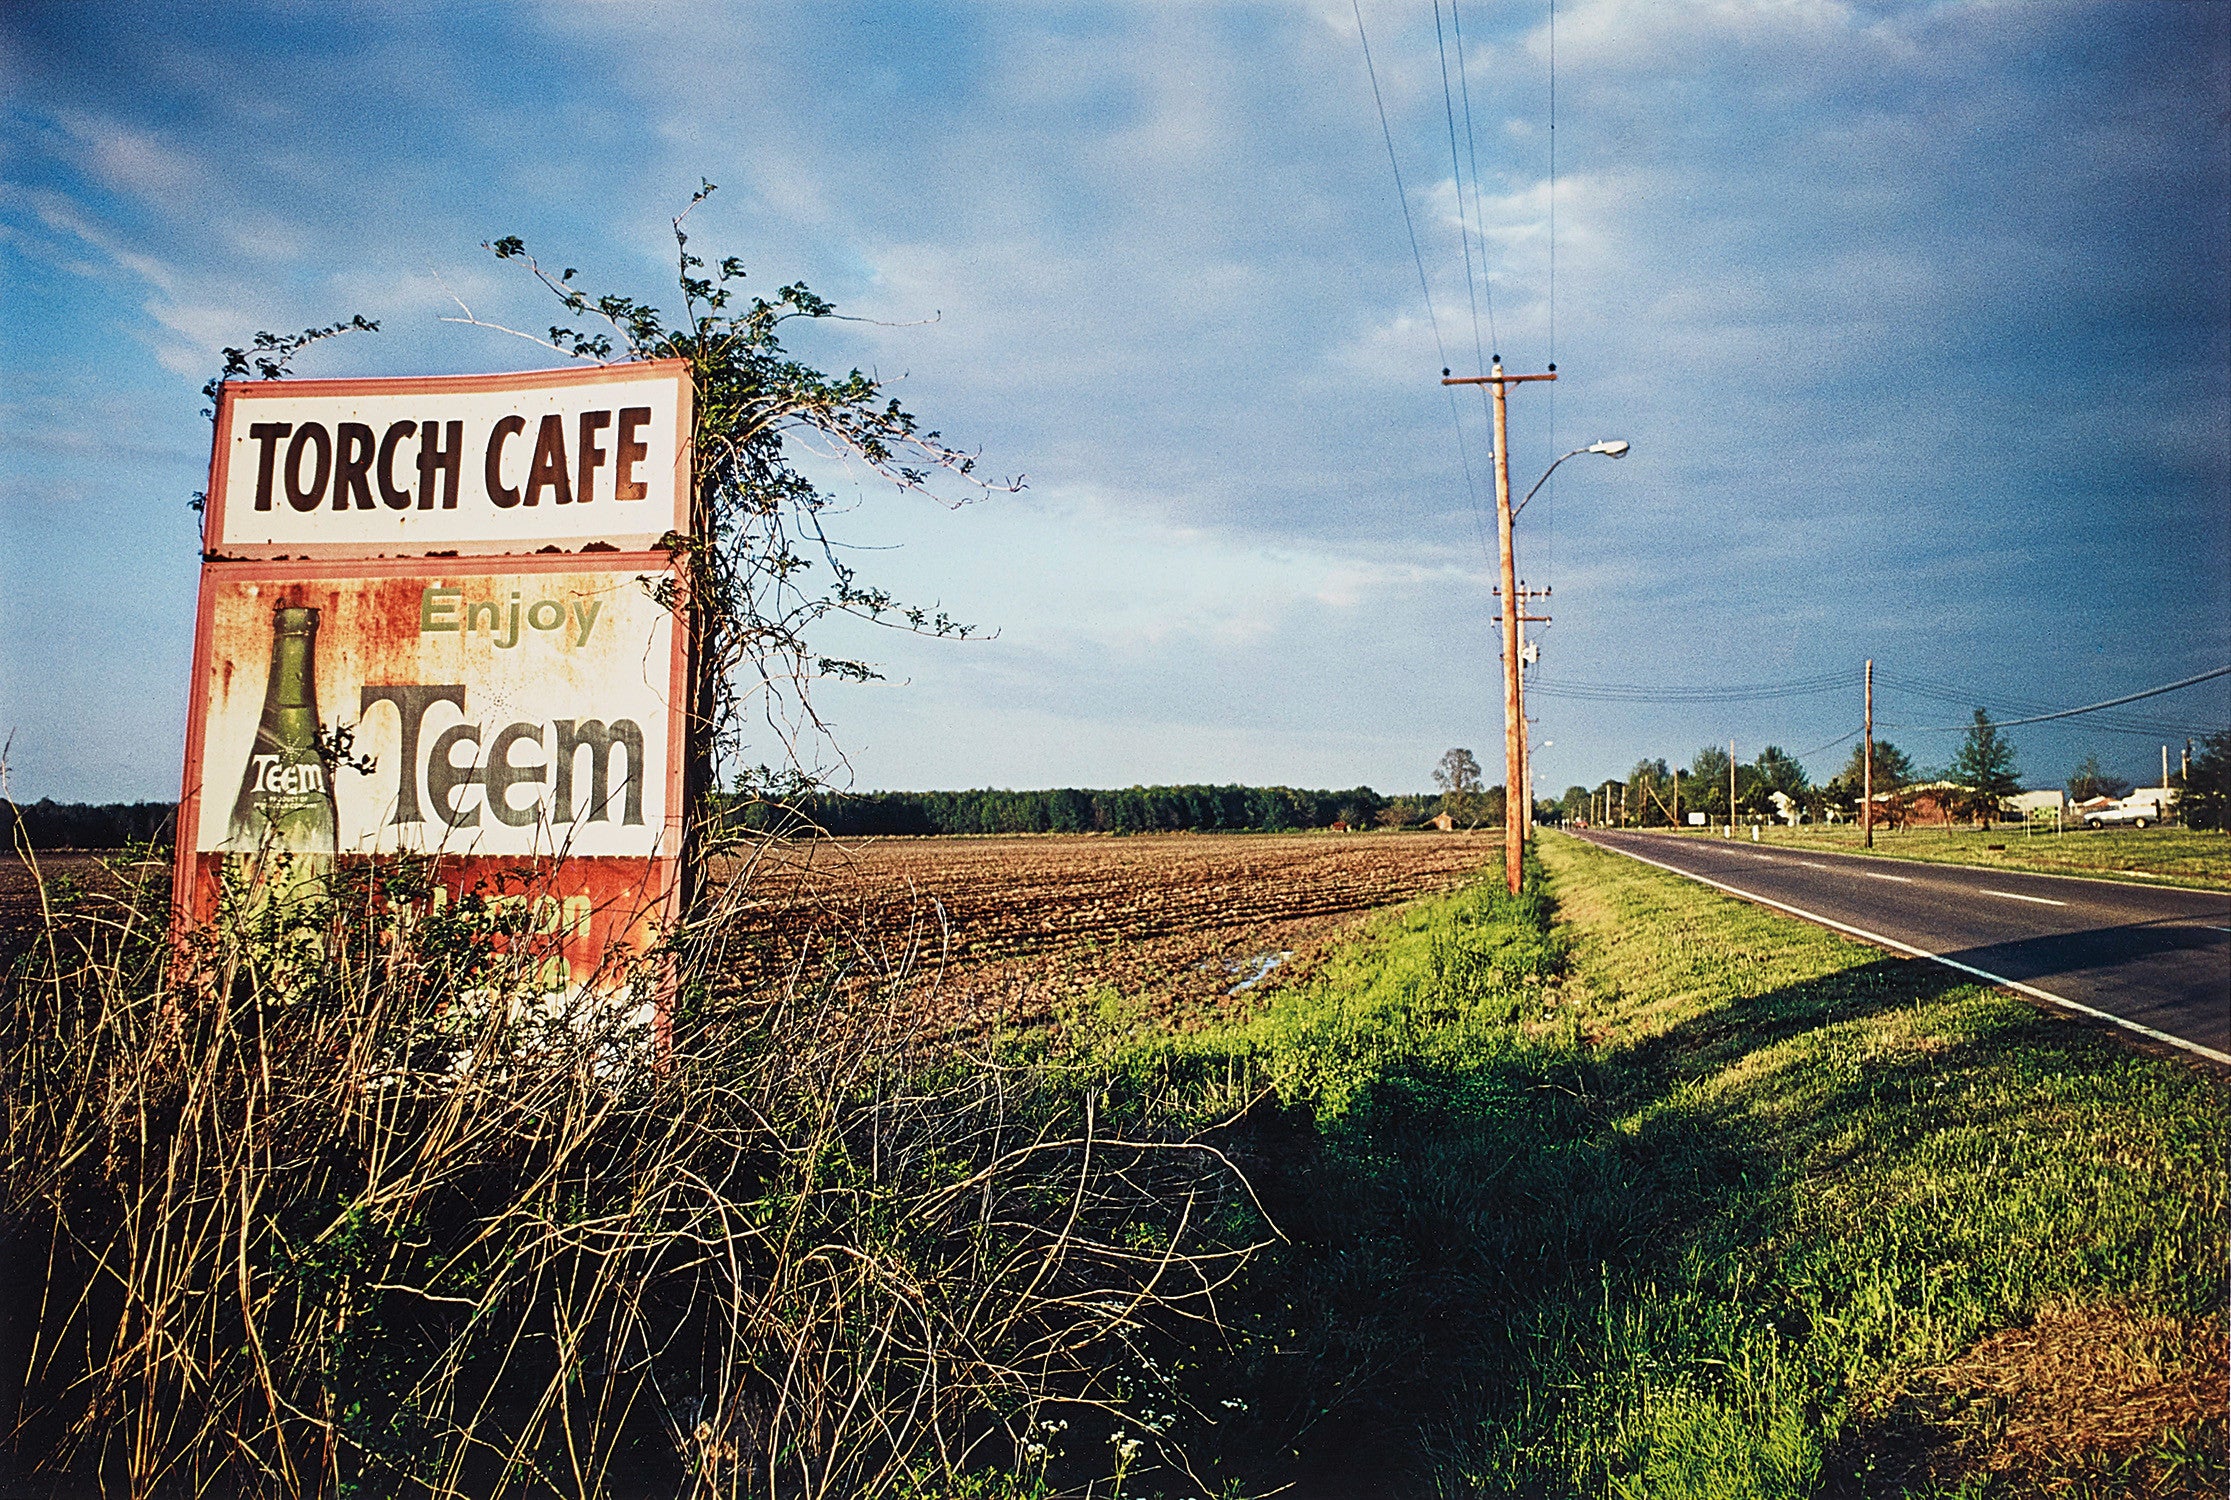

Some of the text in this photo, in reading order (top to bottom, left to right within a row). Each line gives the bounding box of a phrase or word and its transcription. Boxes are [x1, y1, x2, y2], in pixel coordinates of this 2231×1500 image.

[249, 407, 652, 513] TORCH CAFE
[420, 587, 603, 649] Enjoy
[250, 754, 327, 795] Teem
[359, 684, 646, 828] Teem
